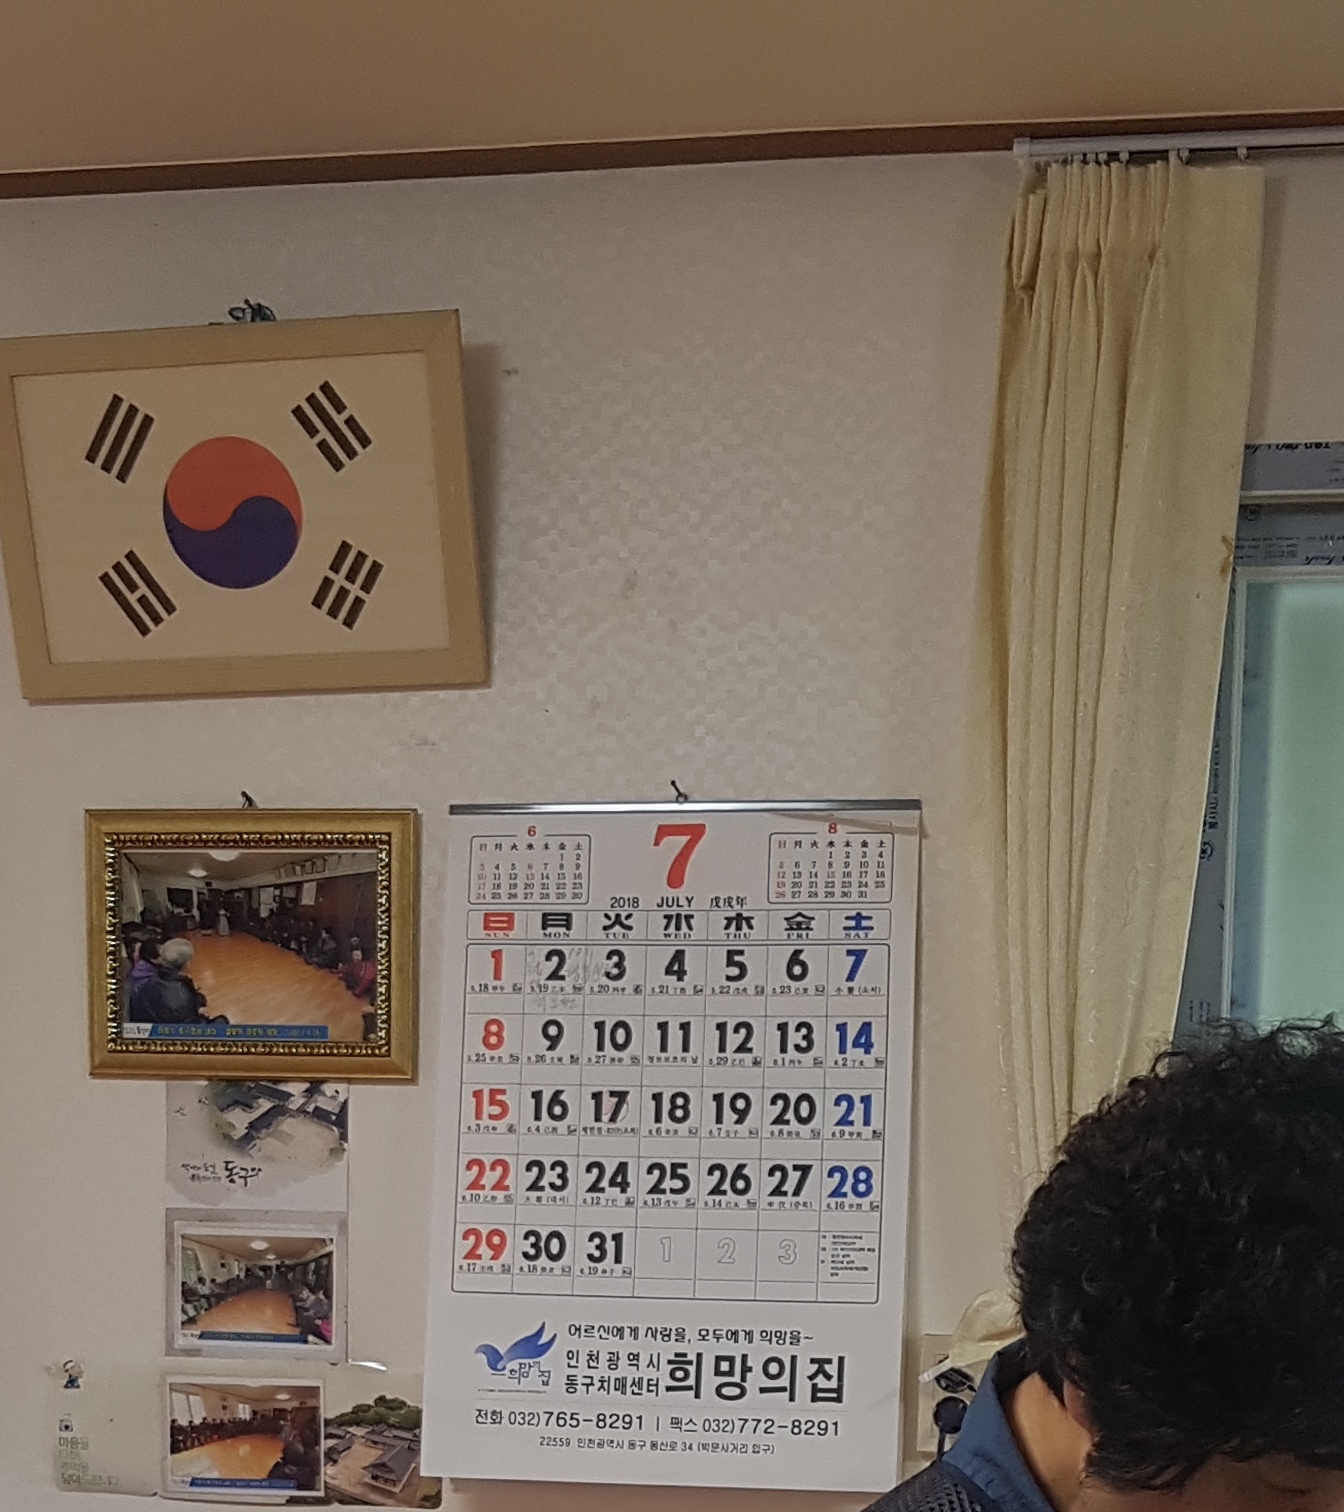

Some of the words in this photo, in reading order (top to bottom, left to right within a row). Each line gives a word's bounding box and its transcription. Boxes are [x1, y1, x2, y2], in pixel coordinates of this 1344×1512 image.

[528, 826, 537, 837] 6
[828, 822, 837, 834] 8
[653, 823, 707, 890] 7
[610, 896, 640, 909] 2018
[656, 896, 695, 909] JULY
[483, 912, 515, 931] 日
[541, 912, 573, 931] 月
[602, 912, 634, 931] 火
[663, 912, 695, 931] 水
[723, 912, 755, 931] 木
[783, 911, 816, 931] 金
[842, 911, 875, 931] 土
[490, 949, 504, 981] 1
[544, 949, 566, 981] 2
[605, 949, 627, 982] 3
[664, 949, 687, 982] 4
[725, 949, 748, 982] 5
[785, 949, 809, 982] 6
[845, 949, 869, 983] 7
[482, 1018, 505, 1051] 8
[541, 1019, 565, 1052] 9
[594, 1020, 633, 1052] 10
[657, 1021, 691, 1053] 11
[715, 1021, 754, 1054] 12
[776, 1021, 815, 1054] 13
[835, 1021, 875, 1055] 14
[471, 1088, 510, 1121] 15
[531, 1089, 569, 1122] 16
[591, 1090, 630, 1123] 17
[651, 1091, 691, 1124] 18
[712, 1091, 752, 1125] 19
[769, 1092, 817, 1126] 20
[833, 1093, 873, 1127] 21
[465, 1158, 511, 1191] 22
[525, 1159, 569, 1192] 23
[585, 1161, 631, 1194] 24
[646, 1162, 691, 1195] 25
[706, 1163, 752, 1196] 26
[767, 1163, 814, 1197] 27
[826, 1165, 874, 1199] 28
[461, 1227, 508, 1261] 29
[521, 1229, 567, 1263] 30
[586, 1231, 624, 1264] 31
[660, 1236, 672, 1263] 1
[717, 1237, 736, 1264] 2
[778, 1238, 797, 1265] 3
[568, 1323, 639, 1341] 어르신에게
[644, 1326, 692, 1344] 사랑을,
[697, 1328, 754, 1344] 모두에게
[566, 1350, 661, 1372] 인천광역시
[564, 1374, 660, 1397] 동구치매센터
[665, 1352, 846, 1404] 희망의집
[475, 1409, 504, 1426] 전화
[539, 1436, 571, 1448] 22559
[577, 1438, 624, 1450] 인천광역시
[628, 1440, 646, 1451] 동구
[681, 1442, 693, 1452] 34
